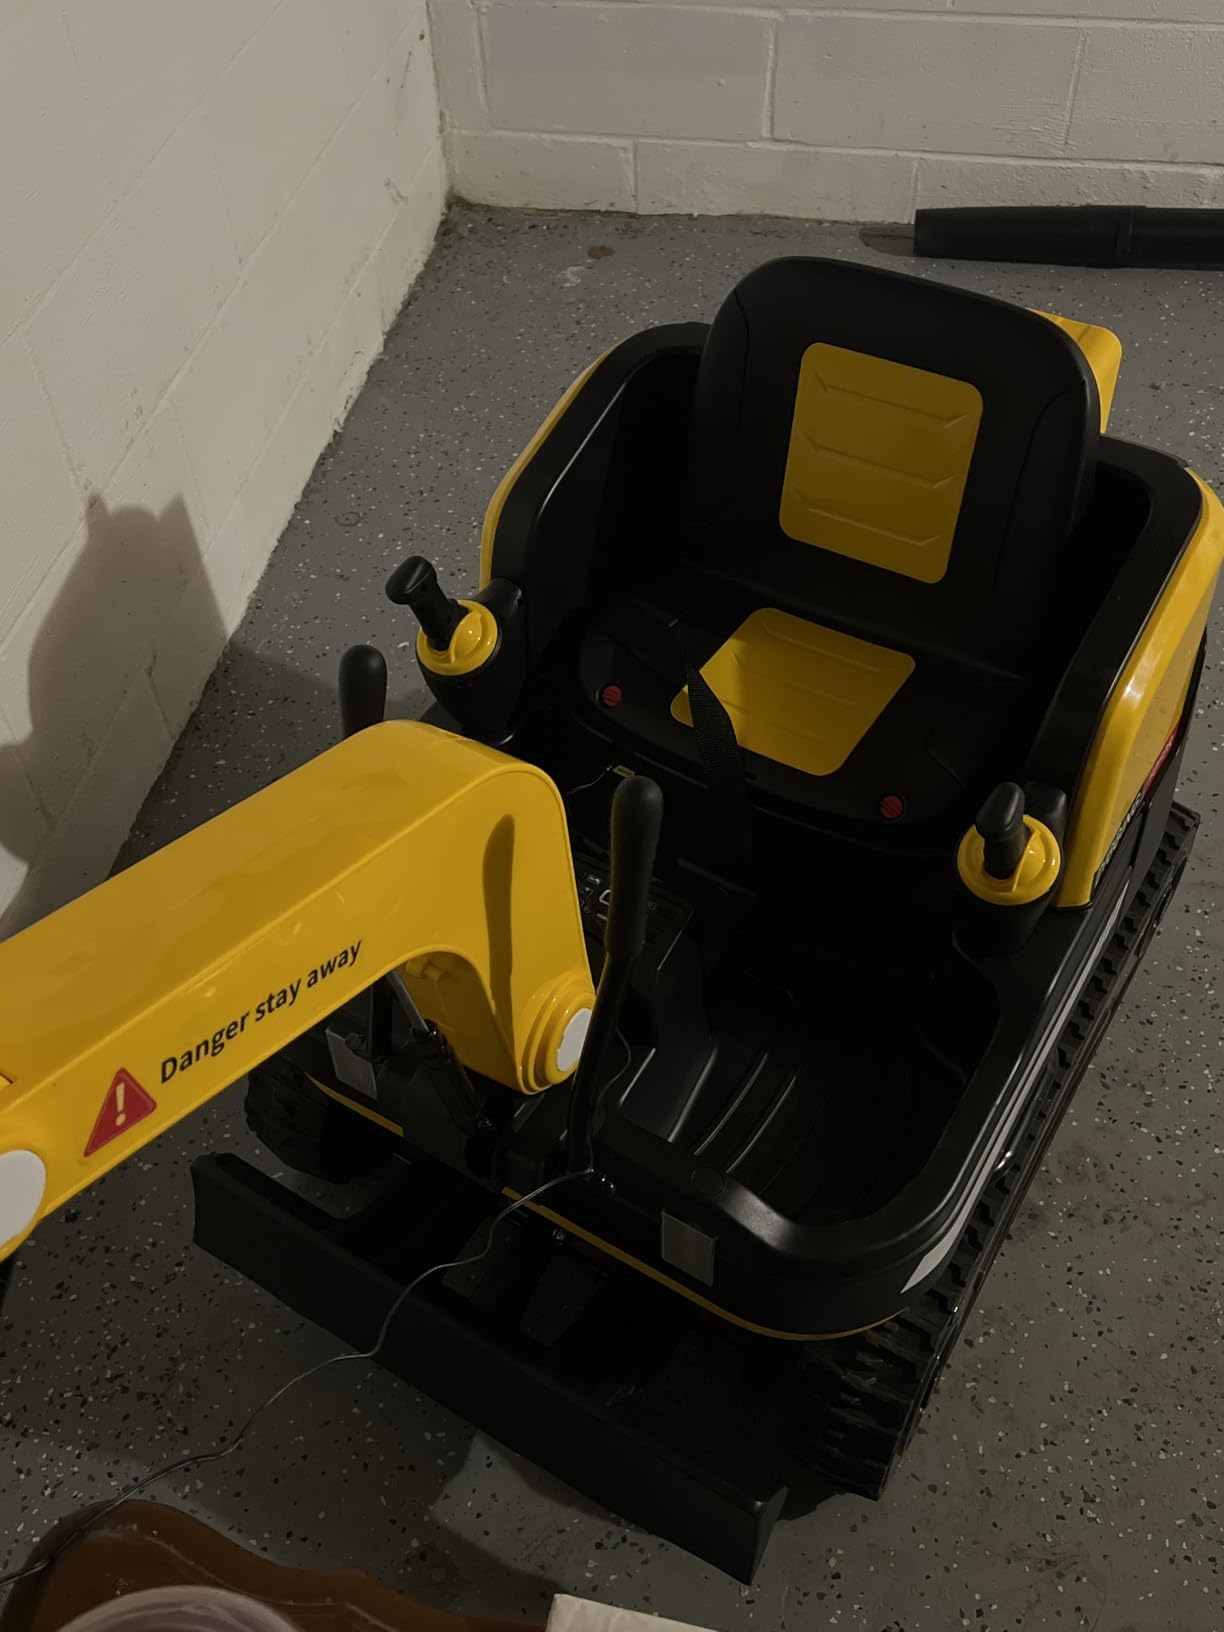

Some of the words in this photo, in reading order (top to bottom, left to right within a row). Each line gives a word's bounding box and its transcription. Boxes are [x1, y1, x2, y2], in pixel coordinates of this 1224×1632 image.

[160, 1011, 250, 1084] Danger
[255, 979, 302, 1022] stay
[306, 940, 362, 988] away
